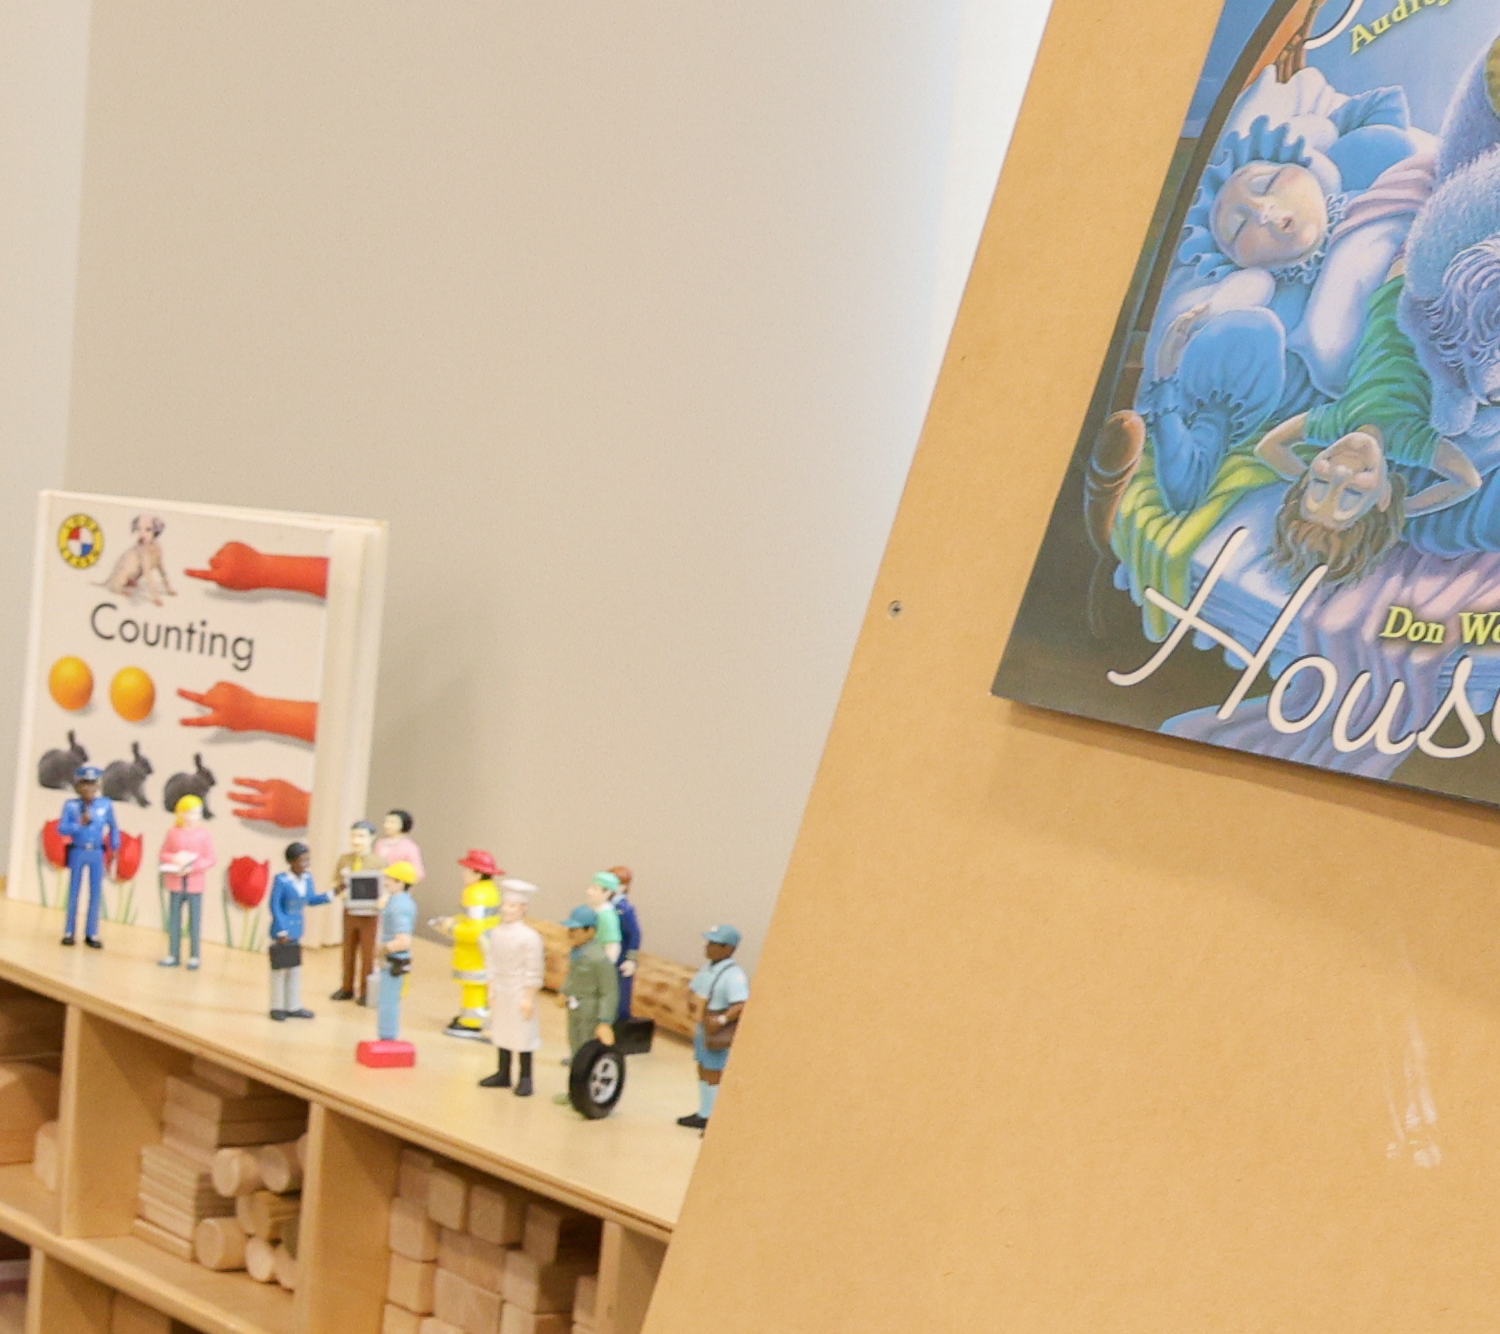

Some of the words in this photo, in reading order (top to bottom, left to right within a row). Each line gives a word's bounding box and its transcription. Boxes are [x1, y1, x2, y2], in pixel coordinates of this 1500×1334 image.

[90, 602, 255, 672] Counting
[1106, 526, 1500, 759] Hous
[1380, 605, 1446, 644] Don
